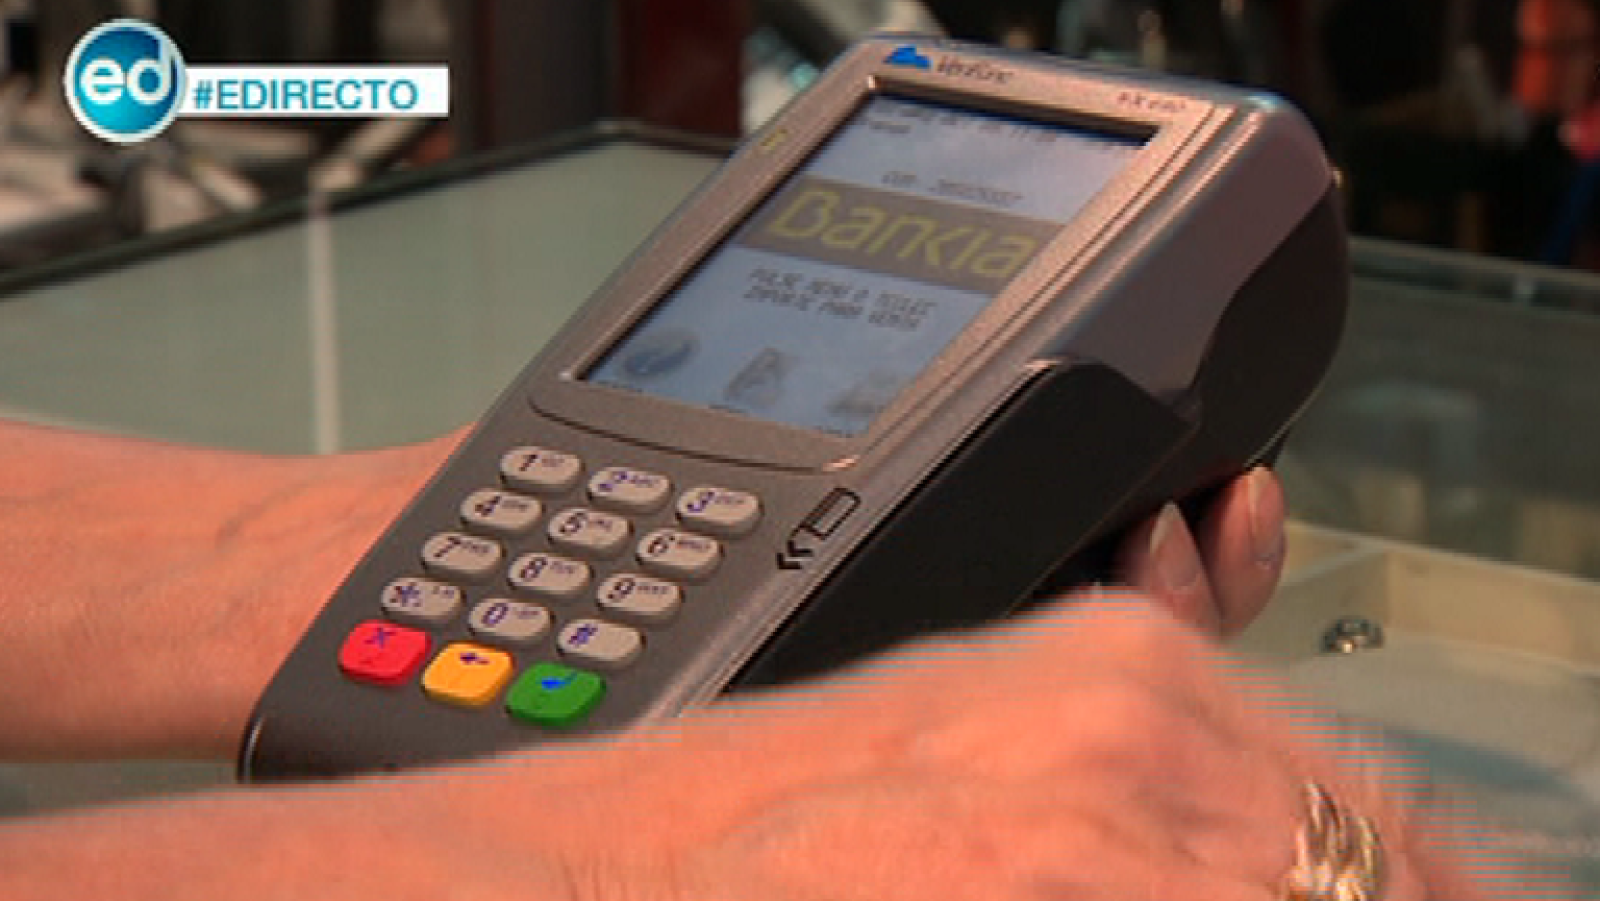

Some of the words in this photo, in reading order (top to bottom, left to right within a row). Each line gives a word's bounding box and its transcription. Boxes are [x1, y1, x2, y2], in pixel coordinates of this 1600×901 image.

[767, 187, 1038, 279] Bankia
[519, 453, 539, 472] 1
[598, 470, 628, 493] 2
[474, 495, 502, 517] 4
[686, 490, 716, 513] 3
[558, 511, 587, 535] 5
[432, 535, 461, 558] 7
[648, 535, 677, 557] 6
[520, 556, 548, 580] 8
[607, 577, 636, 600] 9
[482, 602, 508, 627] 0
